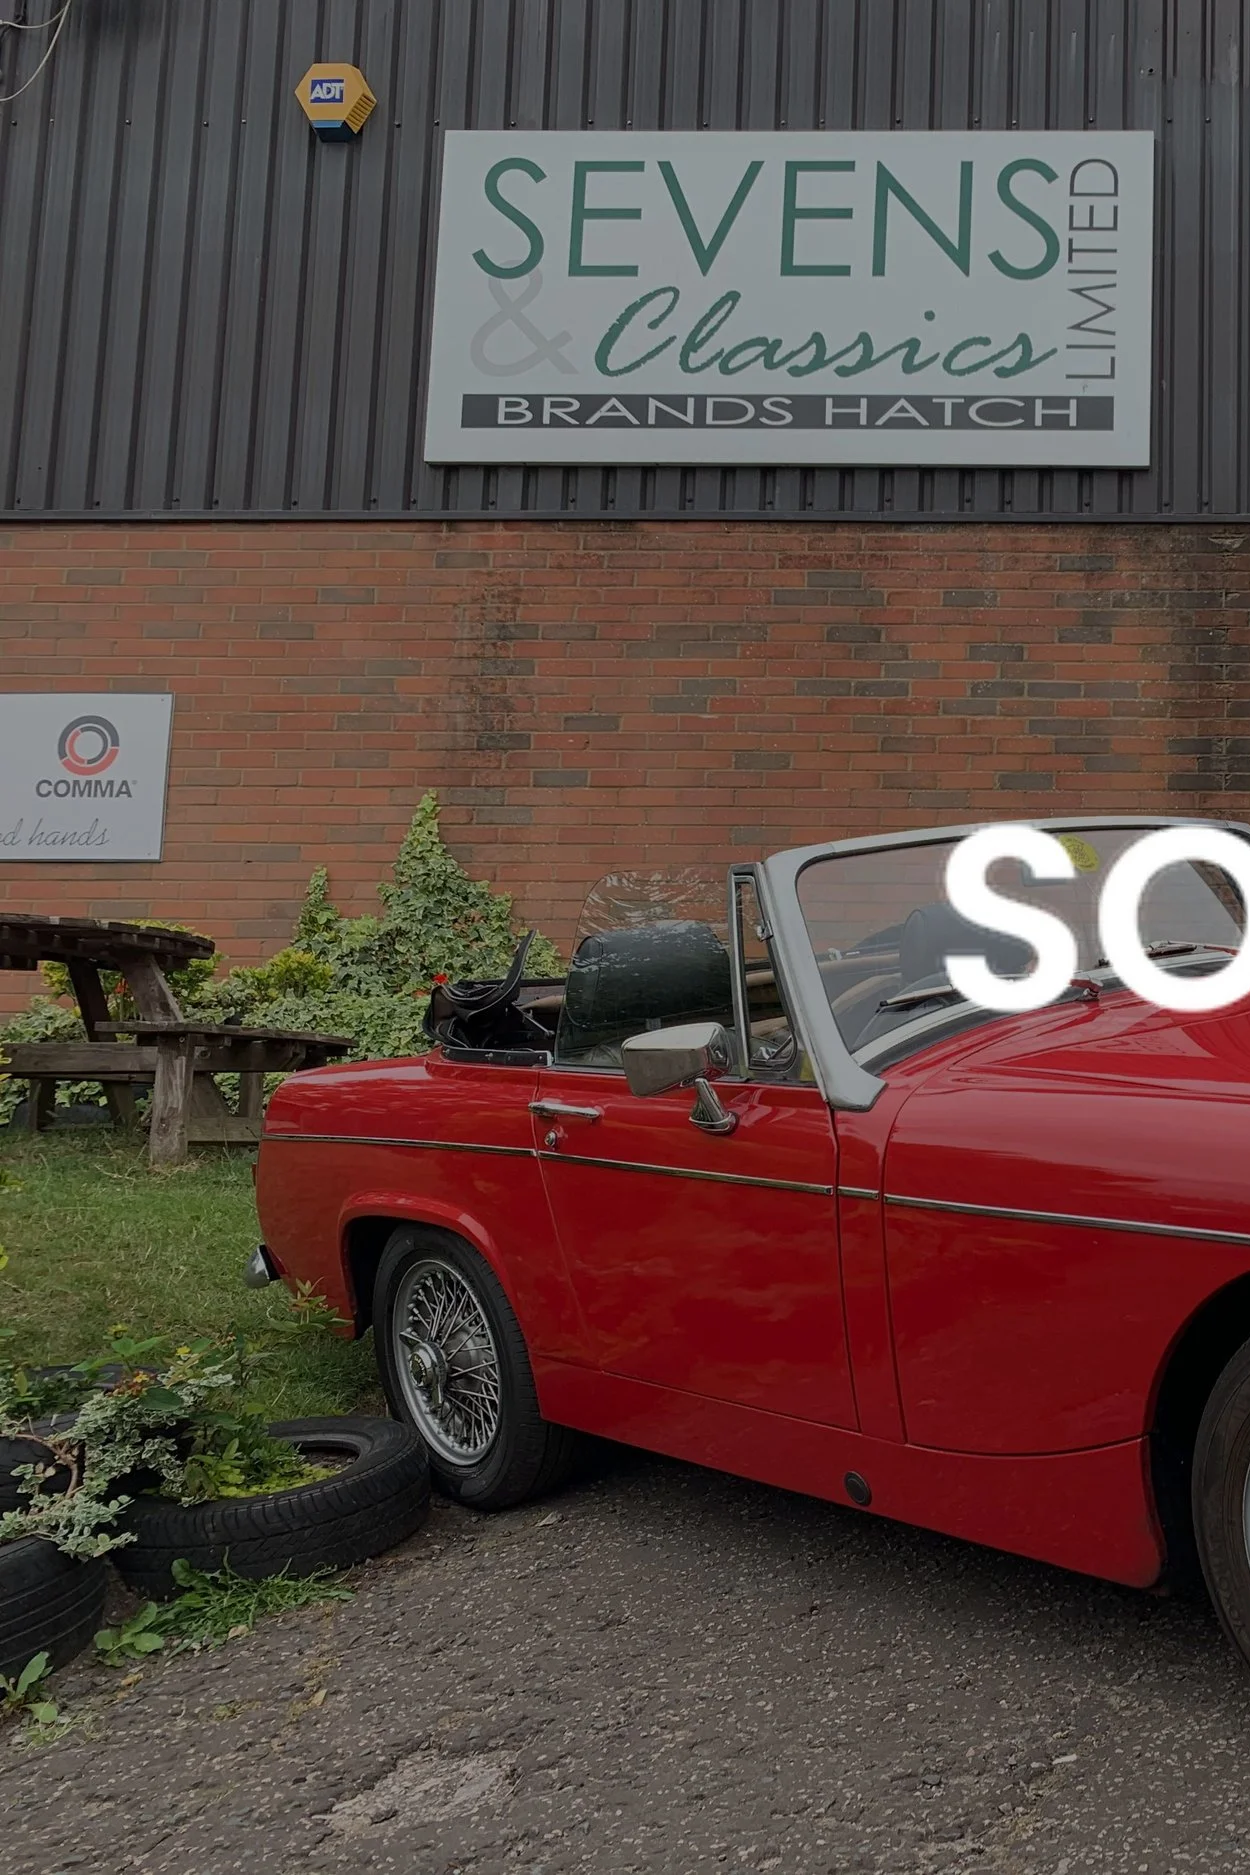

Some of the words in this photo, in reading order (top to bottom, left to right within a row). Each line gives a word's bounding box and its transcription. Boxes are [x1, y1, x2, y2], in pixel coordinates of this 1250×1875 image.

[310, 83, 344, 99] ADT
[472, 157, 1061, 280] SEVENS
[1065, 158, 1119, 380] LIMITED
[470, 259, 579, 377] &
[594, 285, 1058, 379] Classics
[498, 397, 794, 426] BRANDS
[825, 398, 1078, 428] HATCH
[28, 818, 110, 846] hands
